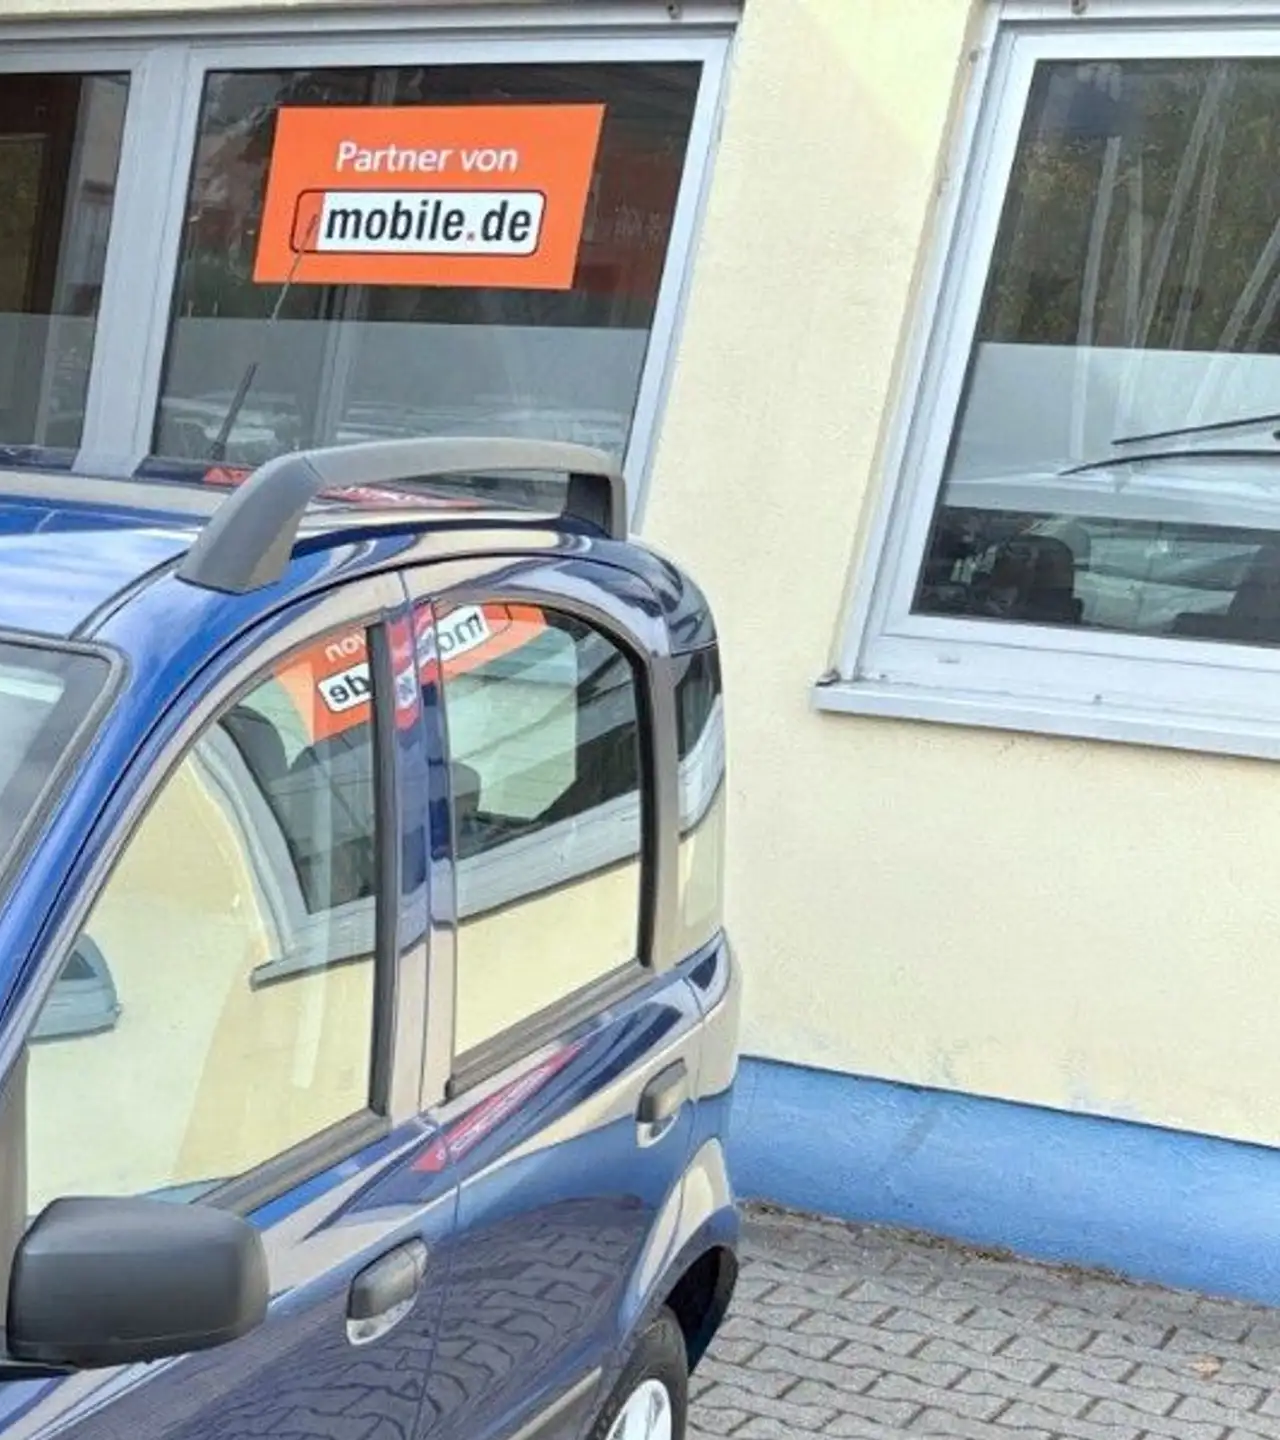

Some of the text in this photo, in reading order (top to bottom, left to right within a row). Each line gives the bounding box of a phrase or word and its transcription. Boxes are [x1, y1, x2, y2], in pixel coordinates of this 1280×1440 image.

[336, 141, 519, 173] Partner von
[325, 199, 533, 242] mobile.de
